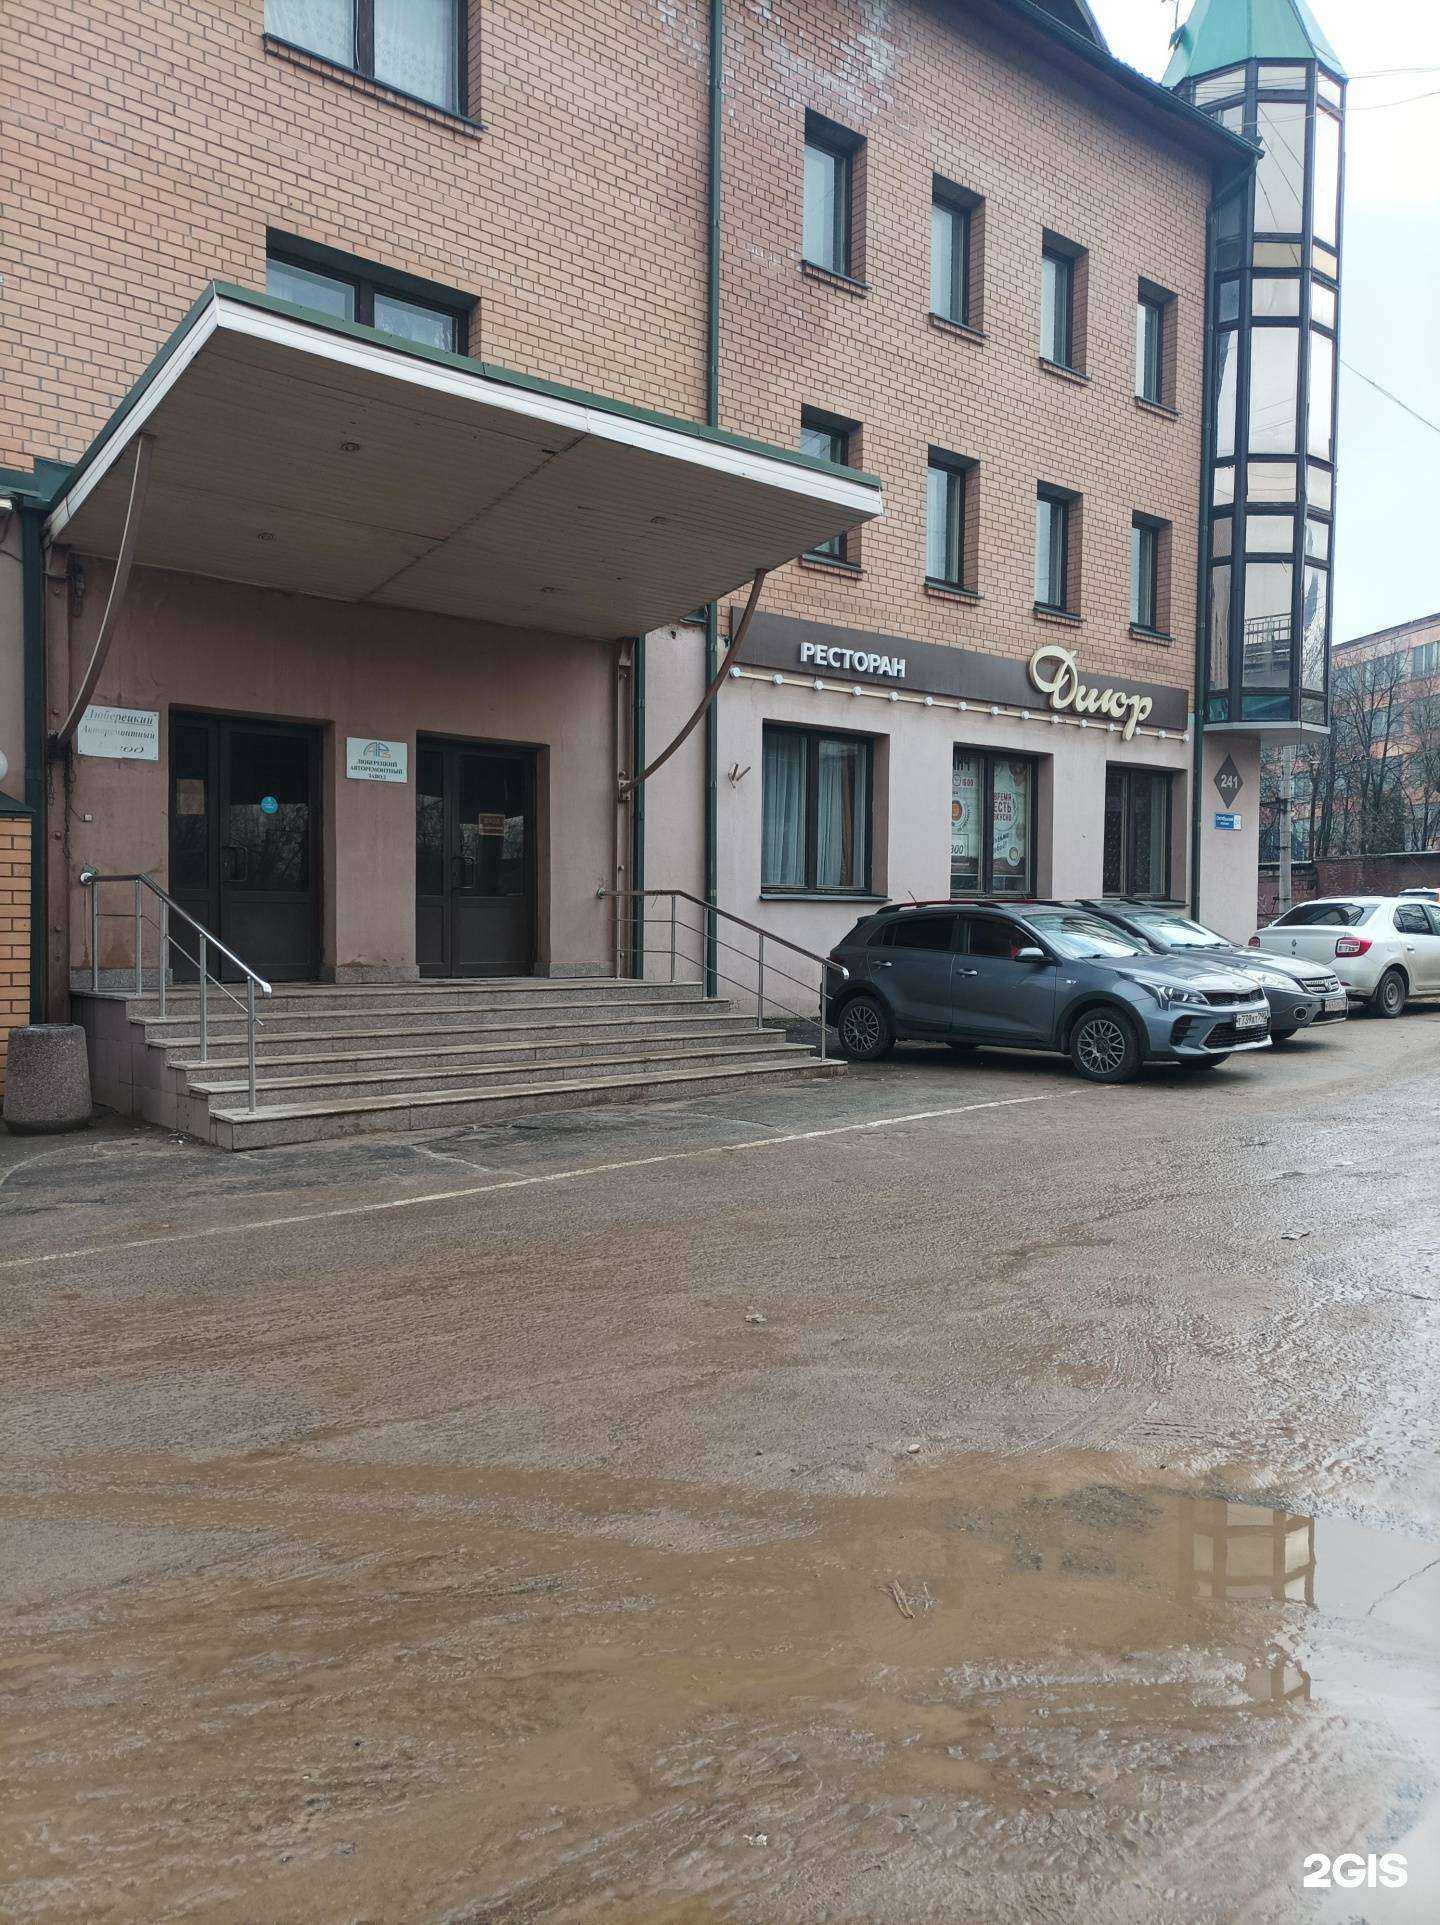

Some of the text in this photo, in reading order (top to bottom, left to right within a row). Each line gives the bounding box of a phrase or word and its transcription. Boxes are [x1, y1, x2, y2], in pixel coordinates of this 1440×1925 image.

[800, 641, 906, 678] РЕСТОРАН
[1220, 774, 1238, 789] 241
[993, 801, 1012, 813] ЕСТЬ
